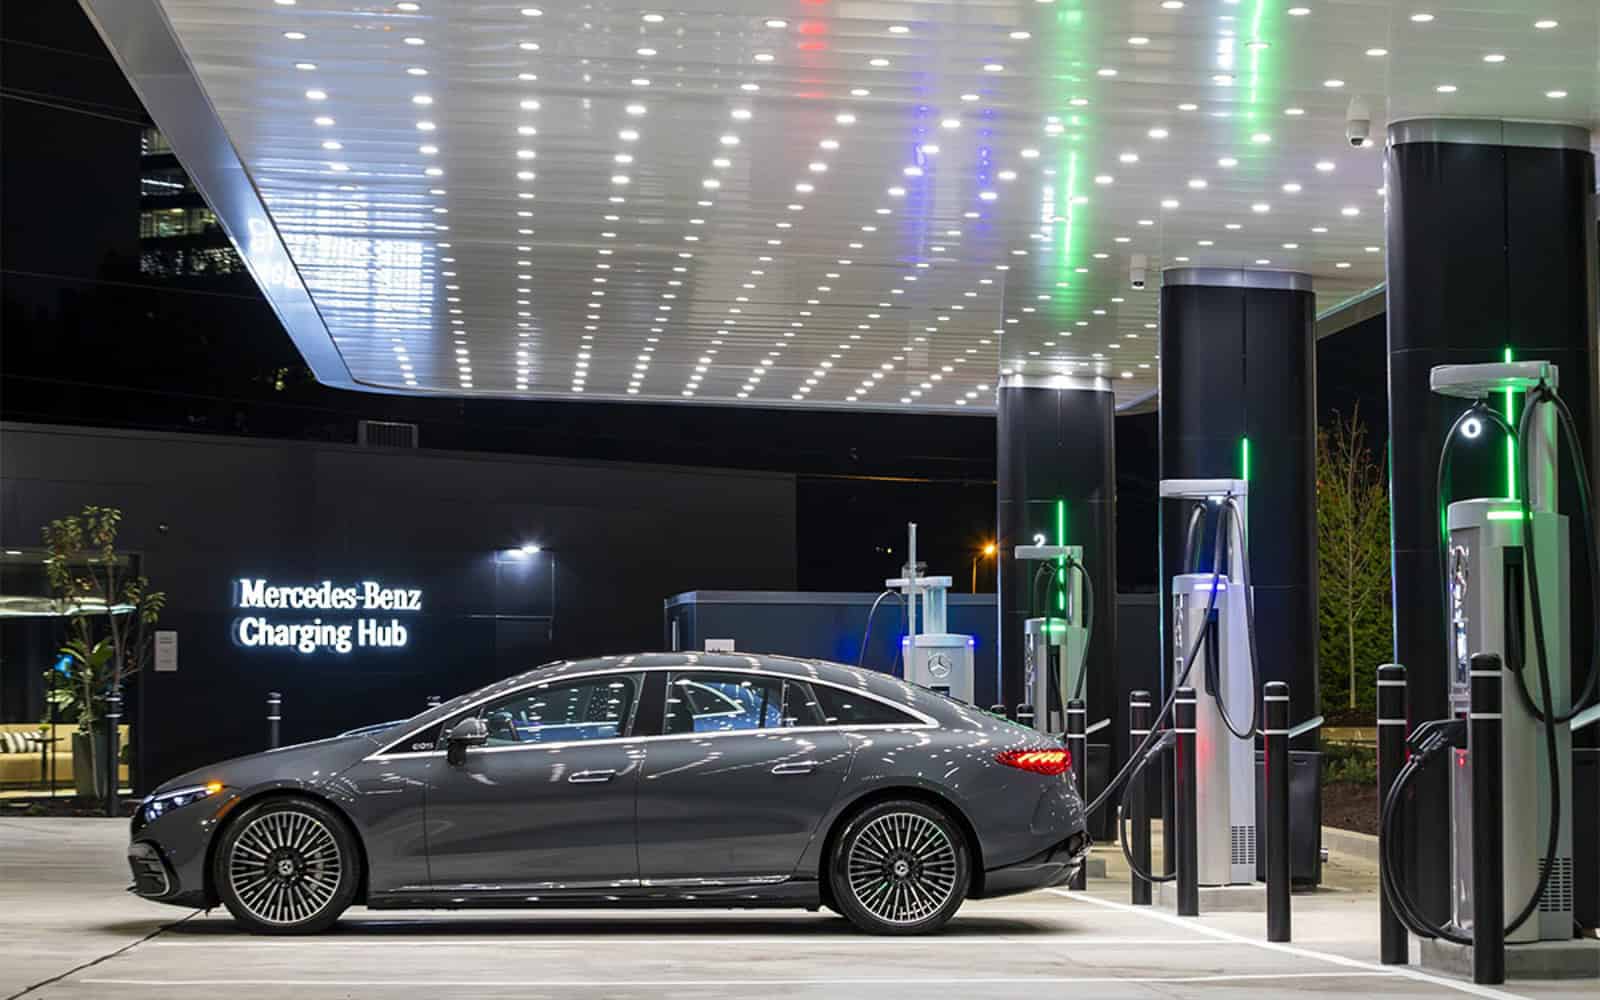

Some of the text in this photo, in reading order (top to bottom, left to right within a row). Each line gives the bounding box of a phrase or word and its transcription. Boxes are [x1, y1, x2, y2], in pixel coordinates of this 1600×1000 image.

[239, 578, 422, 611] Mercedes-Benz
[239, 616, 408, 654] Charging Hub
